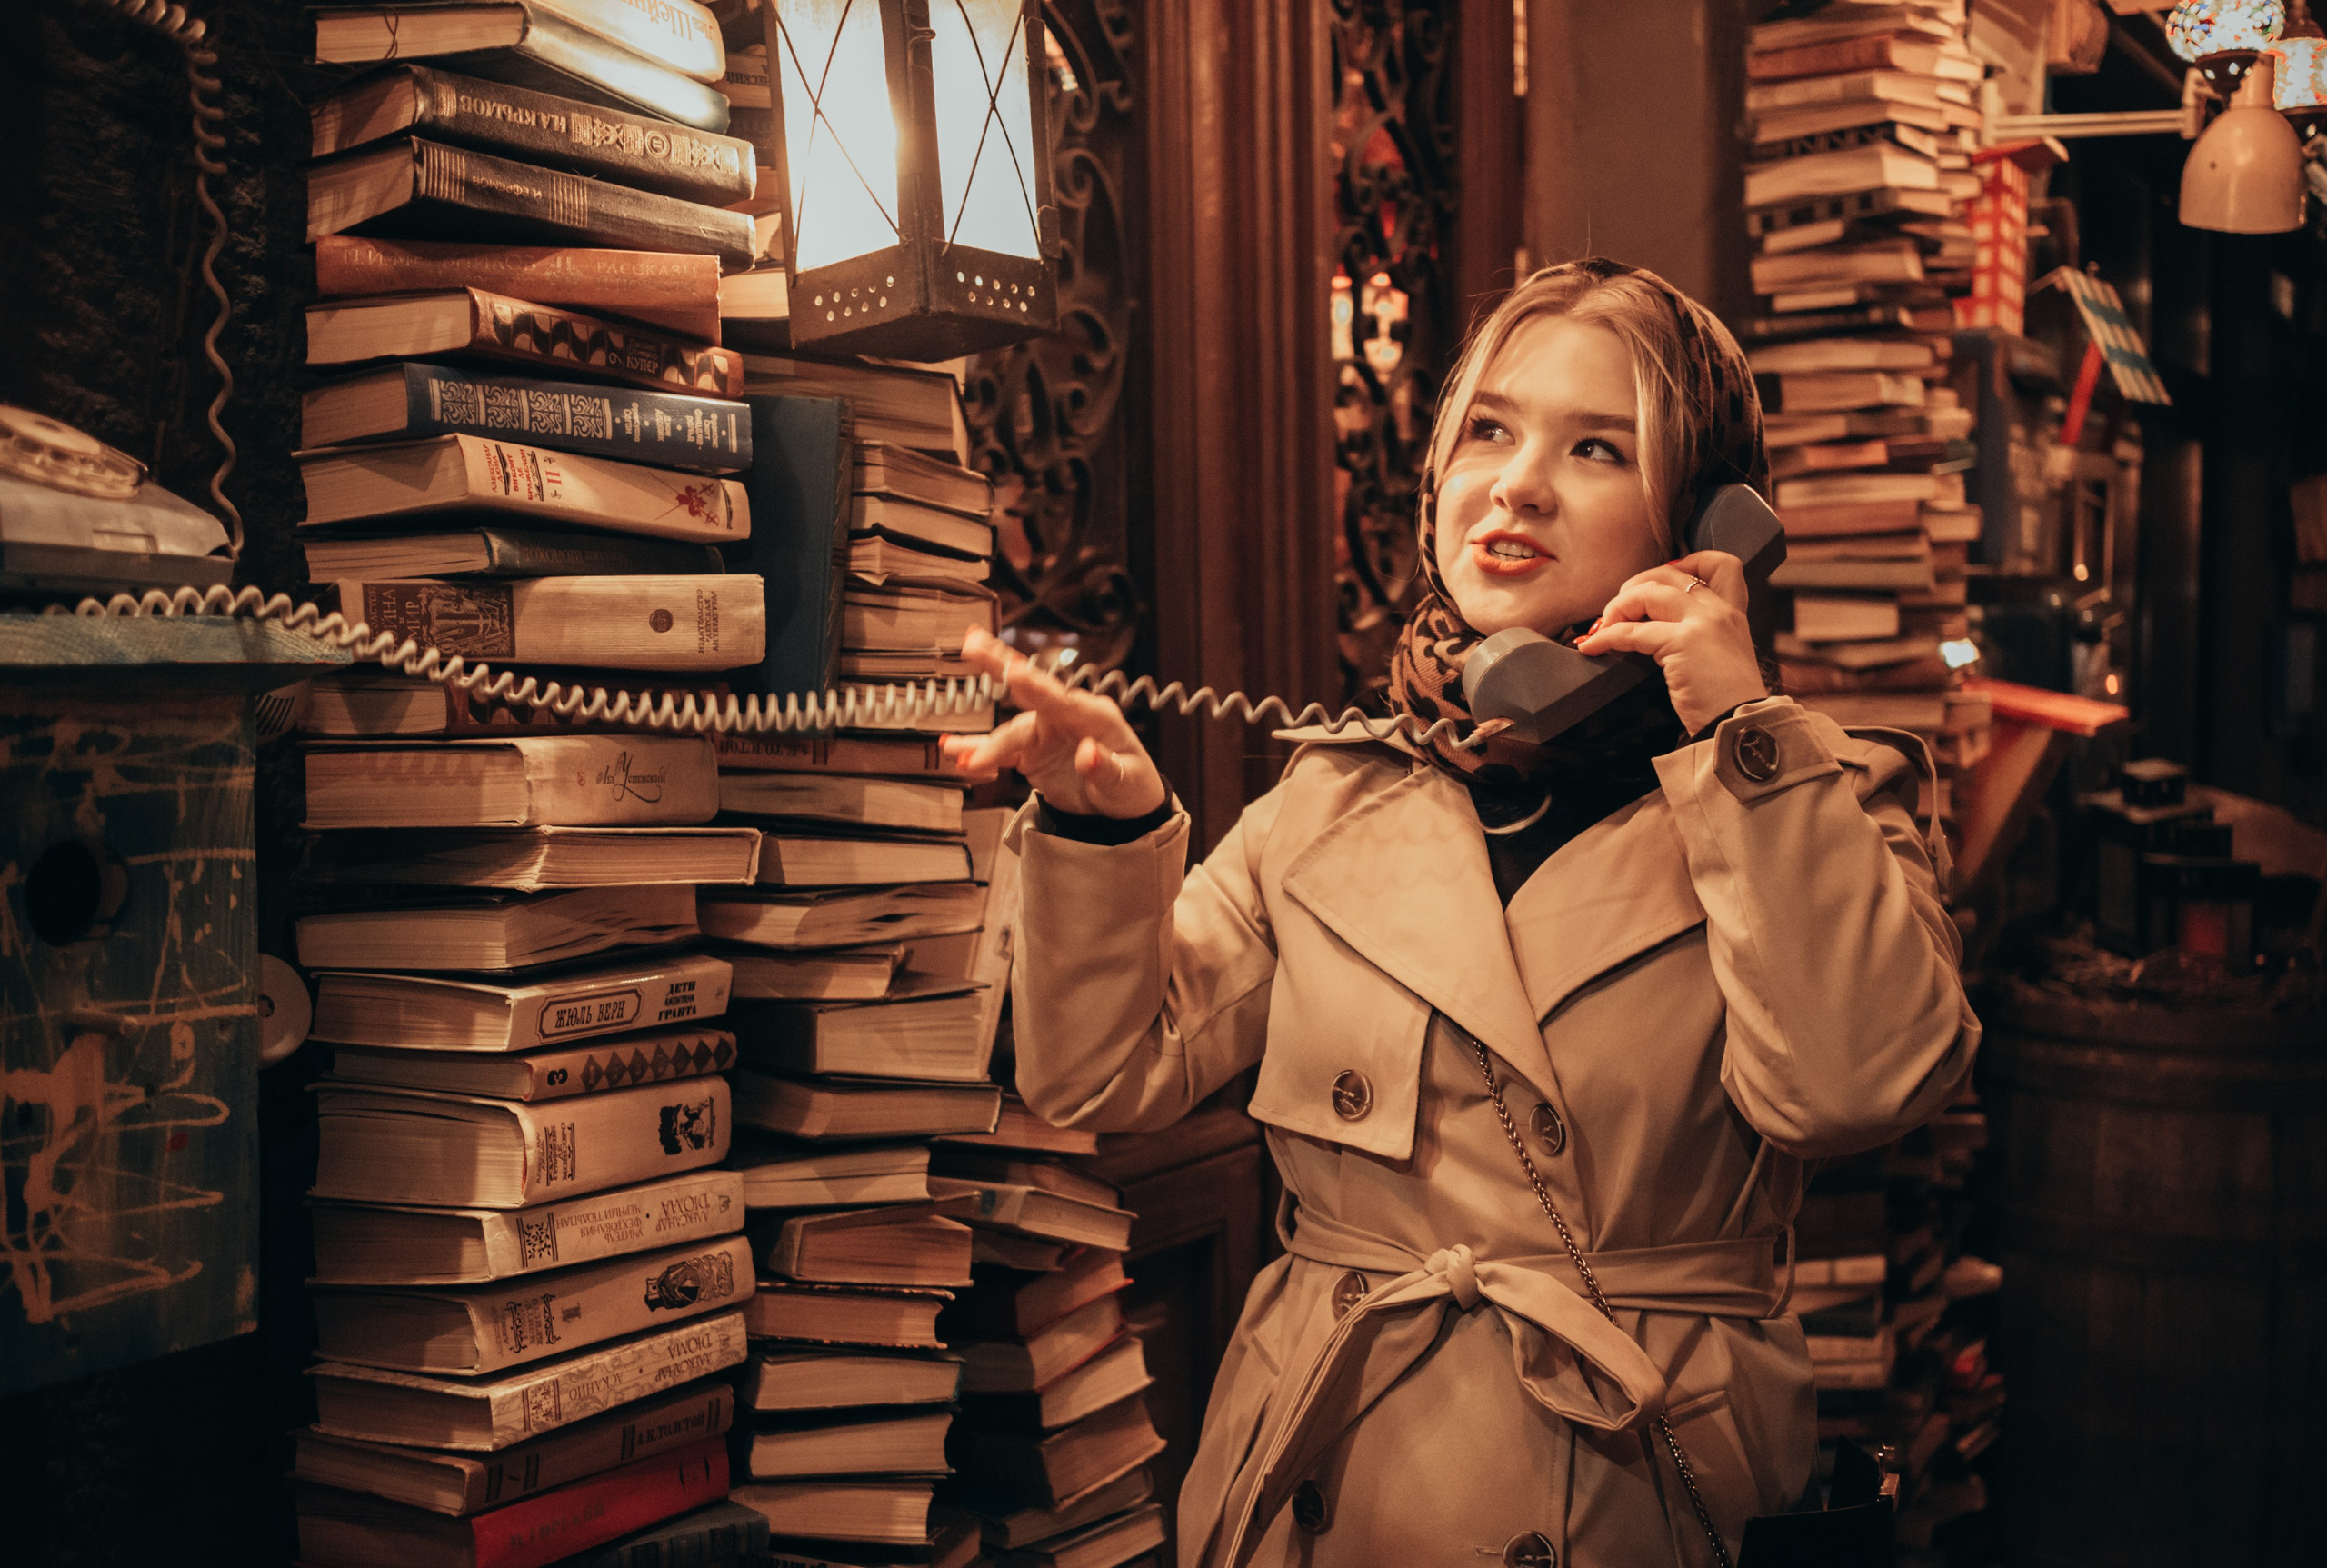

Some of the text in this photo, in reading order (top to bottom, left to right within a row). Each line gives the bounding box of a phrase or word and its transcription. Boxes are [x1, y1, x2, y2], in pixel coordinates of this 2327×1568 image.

[620, 0, 693, 42] Шейн
[596, 261, 699, 278] РАССКАЗЫ
[626, 355, 659, 375] КУПЕР
[482, 444, 498, 494] АЛЕКСАНДР
[492, 454, 504, 484] ДЮМА
[506, 453, 519, 492] ВИКОНТ
[516, 466, 525, 481] ДЕ
[519, 448, 534, 501] БРАЖЕЛОН
[696, 588, 705, 654] ИЗДАТЕЛЬСТВО
[668, 980, 696, 995] ДЕТИ
[554, 1000, 626, 1029] ЖЮЛЬ ВЕРН
[657, 1004, 697, 1021] ГРАНТА
[660, 1193, 711, 1217] ДЮМА
[555, 1210, 603, 1230] ТЮЛЬПАН
[580, 1217, 643, 1239] ФЕХТОВАНИЯ
[655, 1209, 710, 1233] АЛЕКСАНДР
[604, 1227, 644, 1243] УЧИТЕЛЬ
[666, 1333, 713, 1361] ДЮМА
[568, 1371, 624, 1402] АСКАНИО
